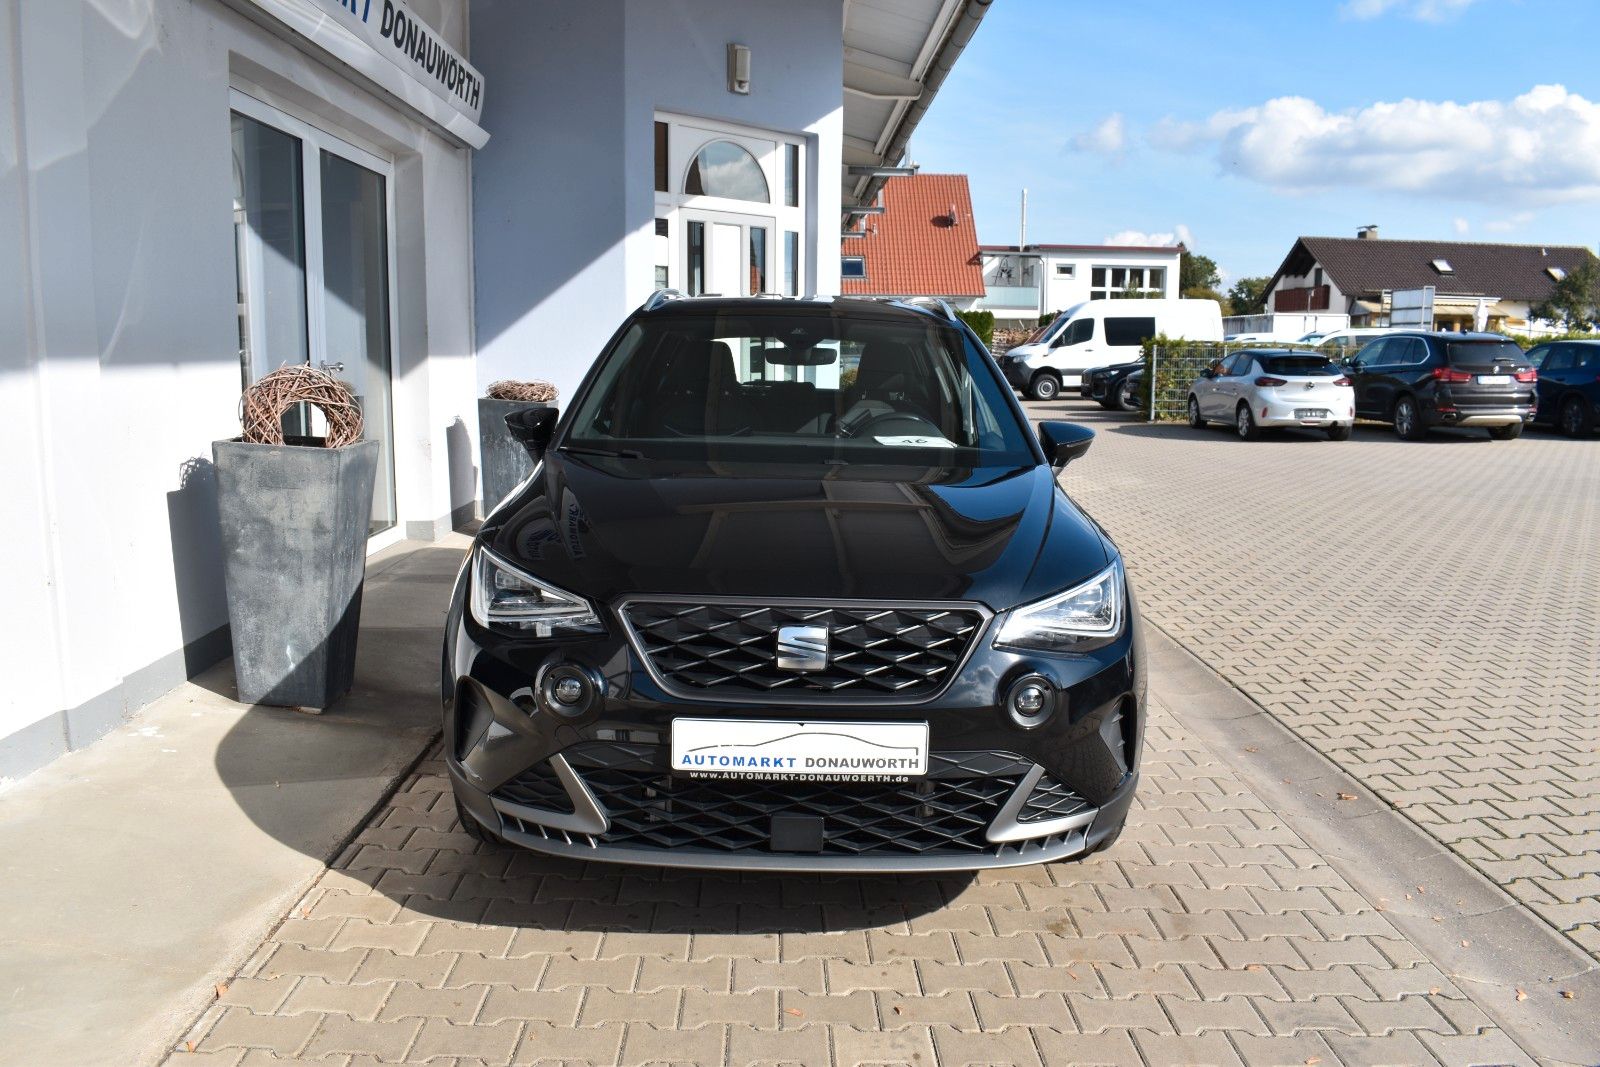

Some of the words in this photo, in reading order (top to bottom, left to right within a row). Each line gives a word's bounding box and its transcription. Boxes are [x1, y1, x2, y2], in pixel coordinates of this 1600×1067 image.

[380, 0, 481, 110] DONAUWÖRTH
[681, 754, 797, 768] AUTOMARKT
[689, 772, 909, 782] www.AUTOMARKT-DONAUWOERTH.de
